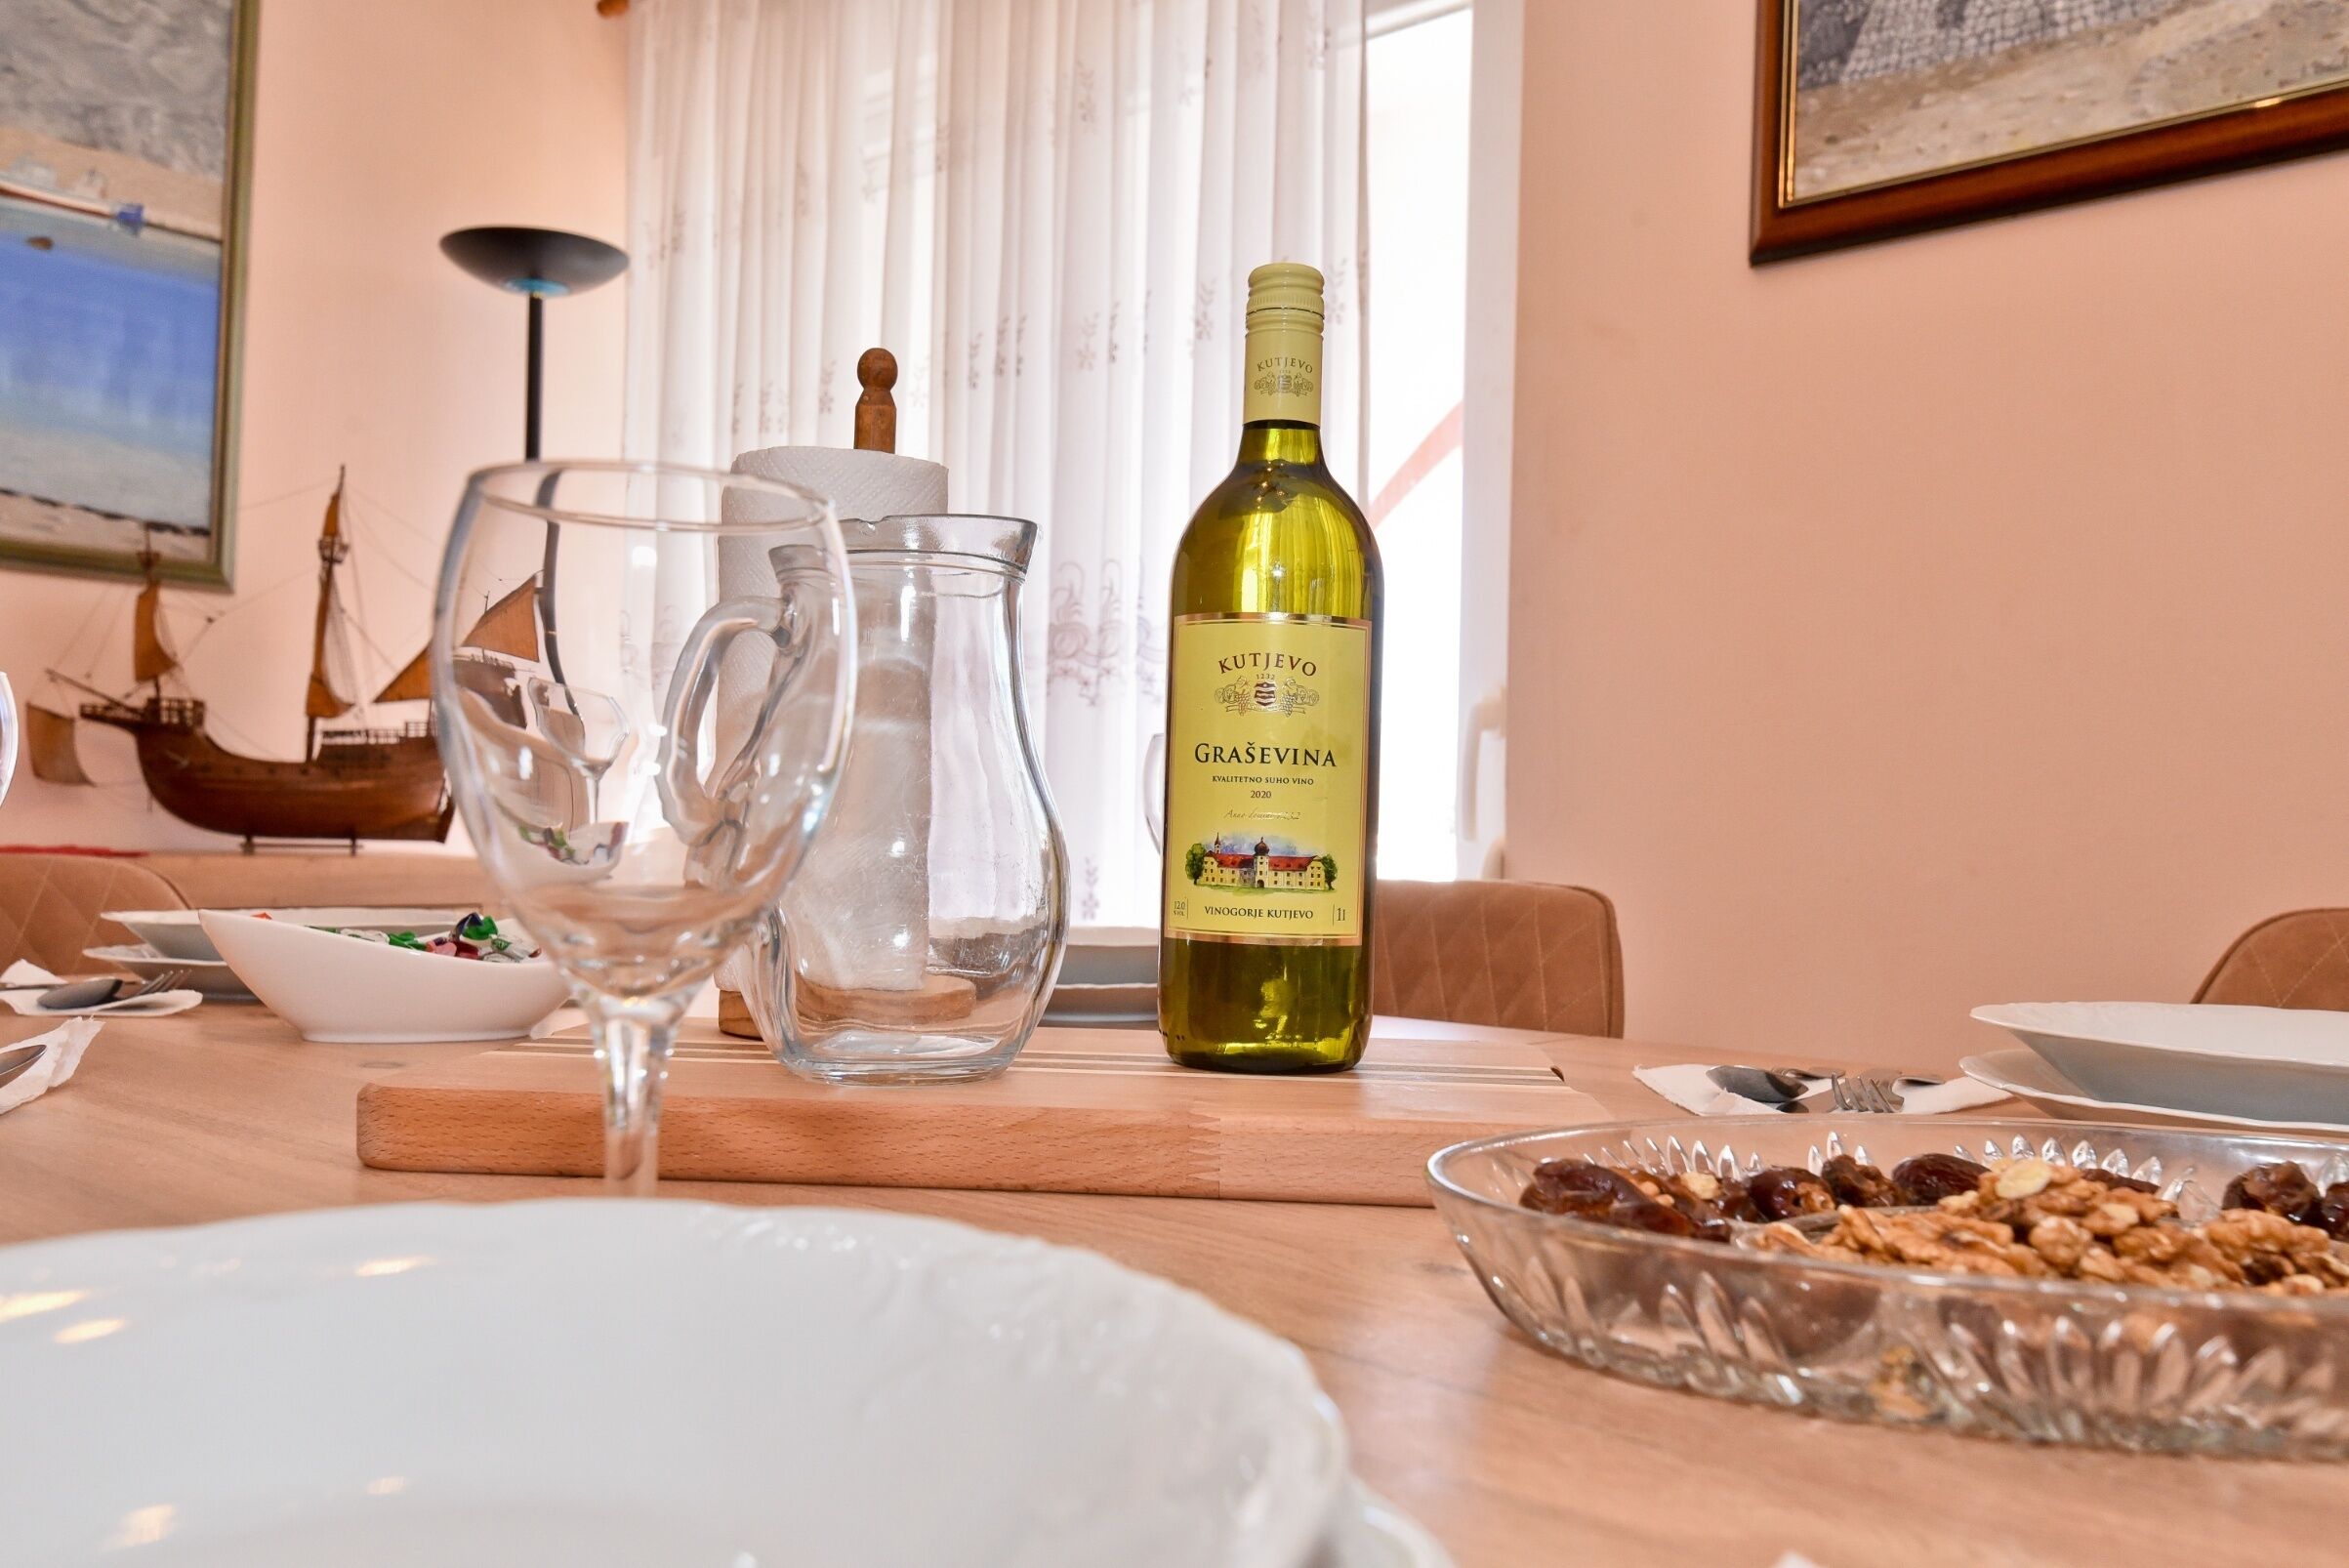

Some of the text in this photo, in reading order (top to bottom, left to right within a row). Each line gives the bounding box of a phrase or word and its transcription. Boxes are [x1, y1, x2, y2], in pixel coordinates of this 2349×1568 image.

[1257, 357, 1313, 374] KUTJEVO
[1217, 652, 1317, 676] KUTJEVO
[1212, 775, 1314, 786] KVALITETNO SUHO VINO
[1250, 789, 1272, 799] 2020
[1205, 906, 1314, 920] VINOGORJE KUTJEVO
